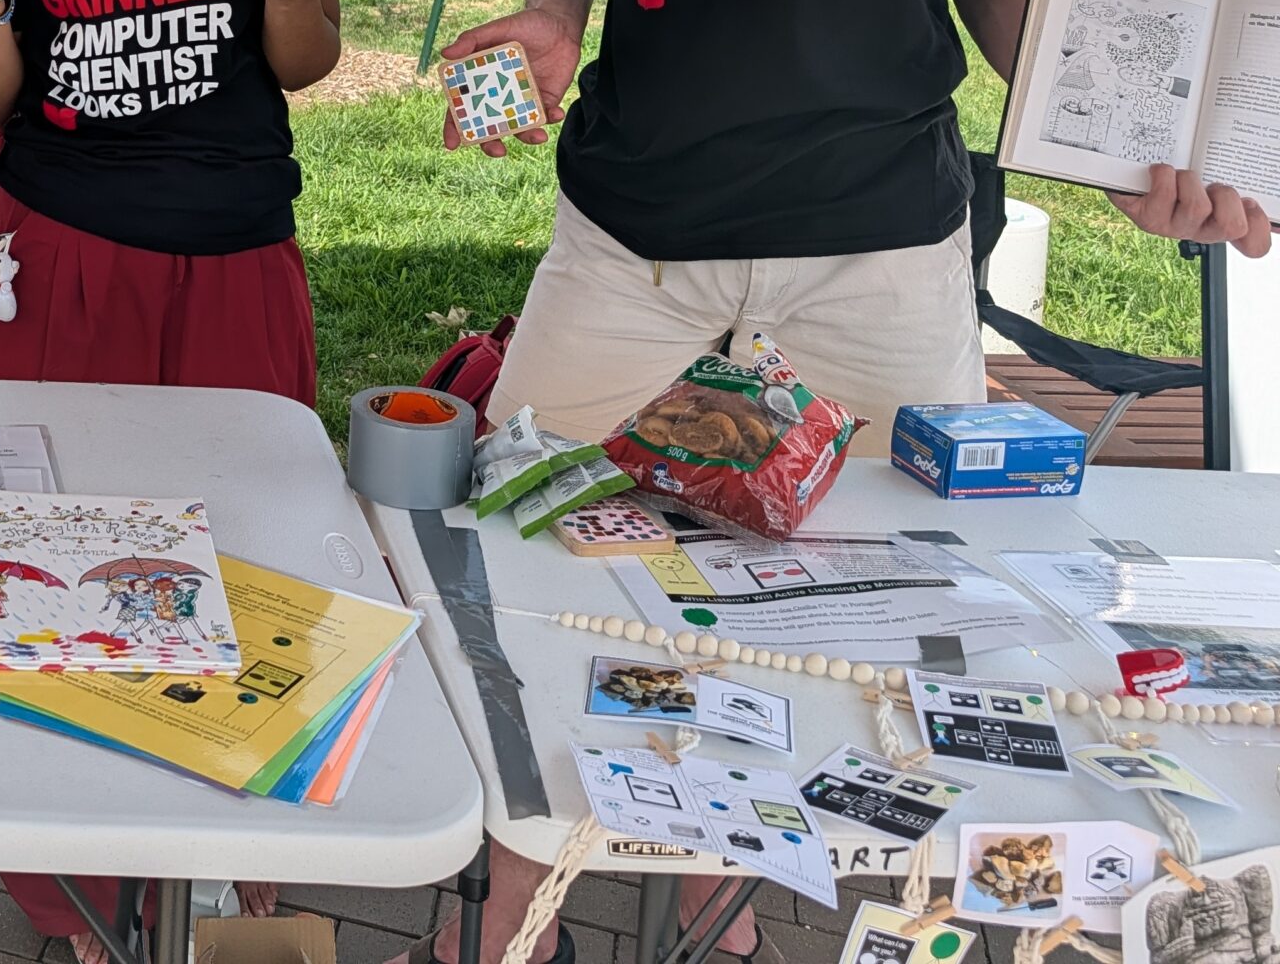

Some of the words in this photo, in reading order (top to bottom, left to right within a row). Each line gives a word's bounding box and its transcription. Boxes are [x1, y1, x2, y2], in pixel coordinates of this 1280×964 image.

[50, 2, 234, 59] COMPUTER
[48, 44, 218, 93] SCIENTIST
[47, 83, 143, 120] LOOKS
[151, 80, 219, 113] LIKE
[666, 446, 680, 459] 500
[680, 449, 689, 462] g
[913, 453, 942, 479] EXPO
[1040, 479, 1075, 495] EXPO
[4, 524, 32, 537] The
[32, 521, 101, 536] English
[681, 595, 706, 603] Who
[707, 594, 750, 603] Listens?
[753, 593, 774, 602] Will
[774, 589, 807, 599] Active
[808, 585, 858, 595] Listening
[619, 842, 688, 856] LIFETIME
[828, 845, 911, 872] ART
[867, 932, 882, 944] What
[883, 935, 894, 945] can
[898, 940, 908, 949] do
[871, 944, 881, 955] for
[880, 946, 897, 958] you?
